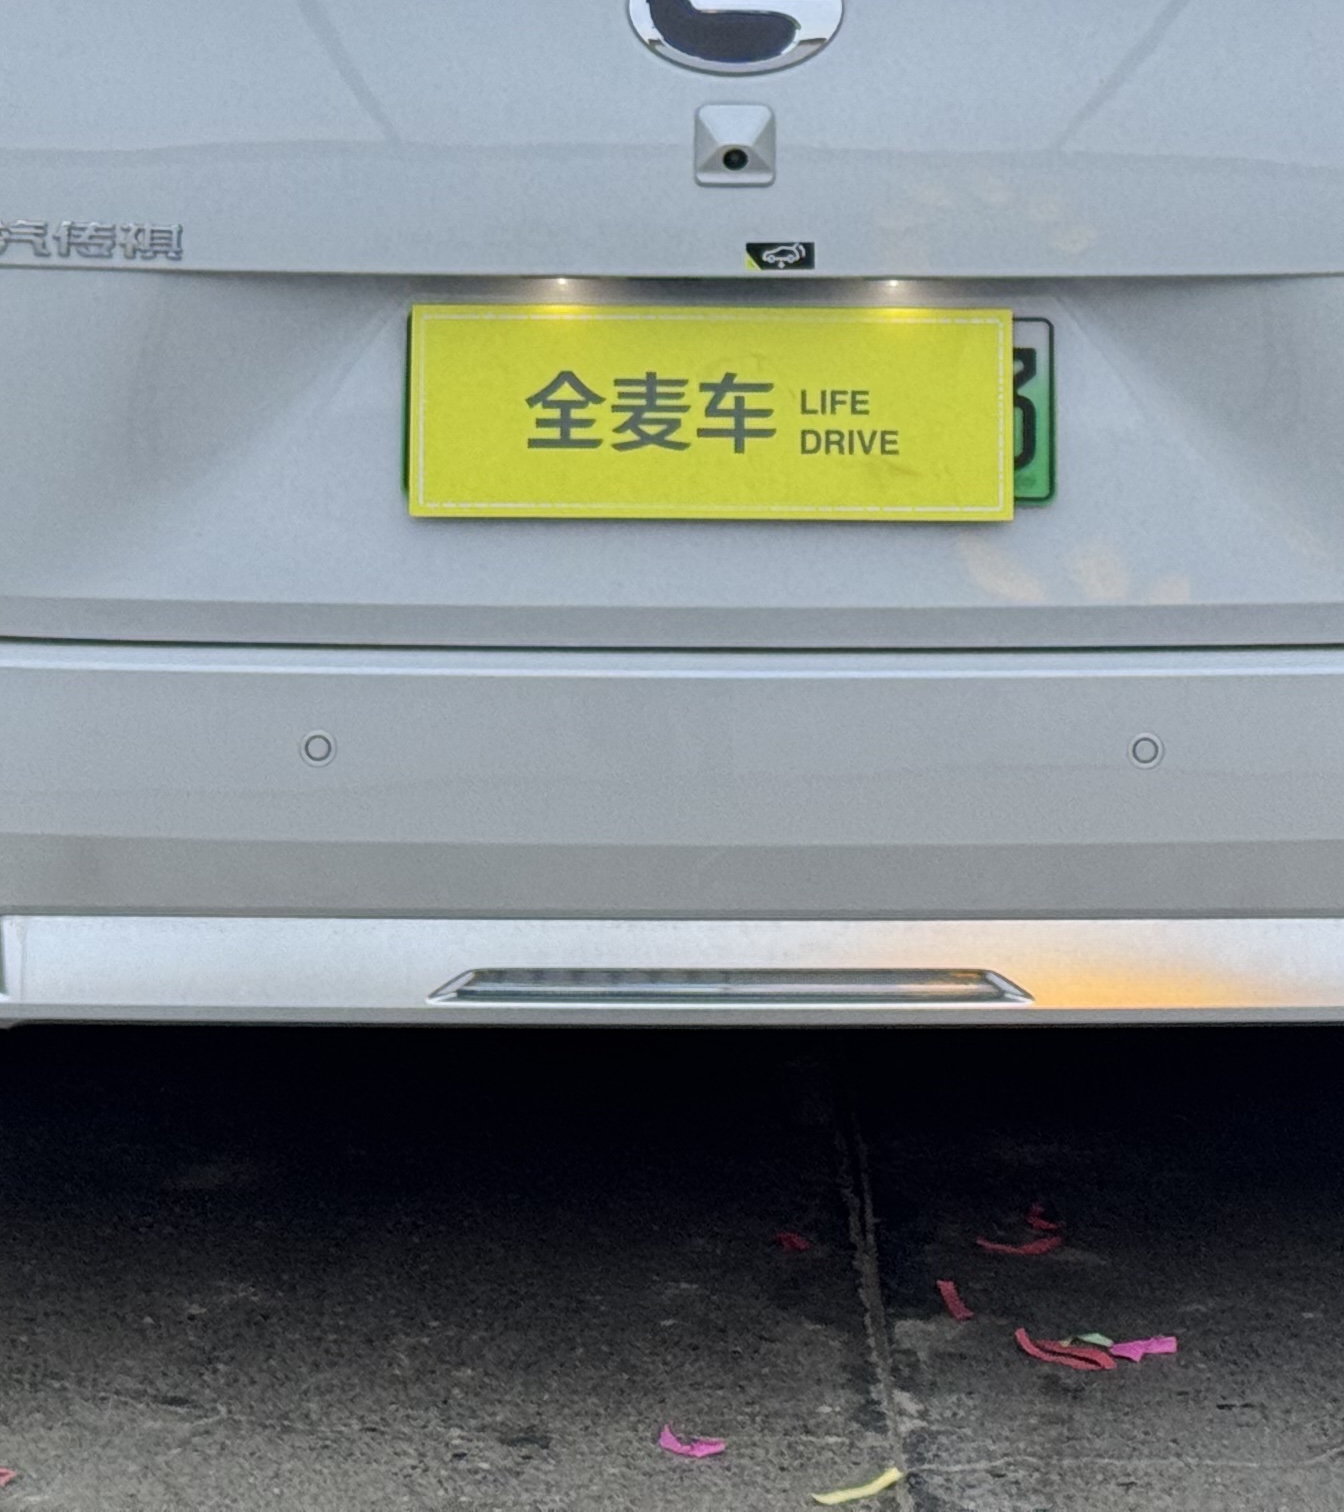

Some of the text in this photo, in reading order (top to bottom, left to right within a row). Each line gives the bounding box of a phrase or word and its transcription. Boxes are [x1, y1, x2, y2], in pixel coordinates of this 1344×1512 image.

[524, 369, 777, 454] 全麦车
[799, 387, 871, 416] LIFE
[799, 429, 901, 455] DRIVE
